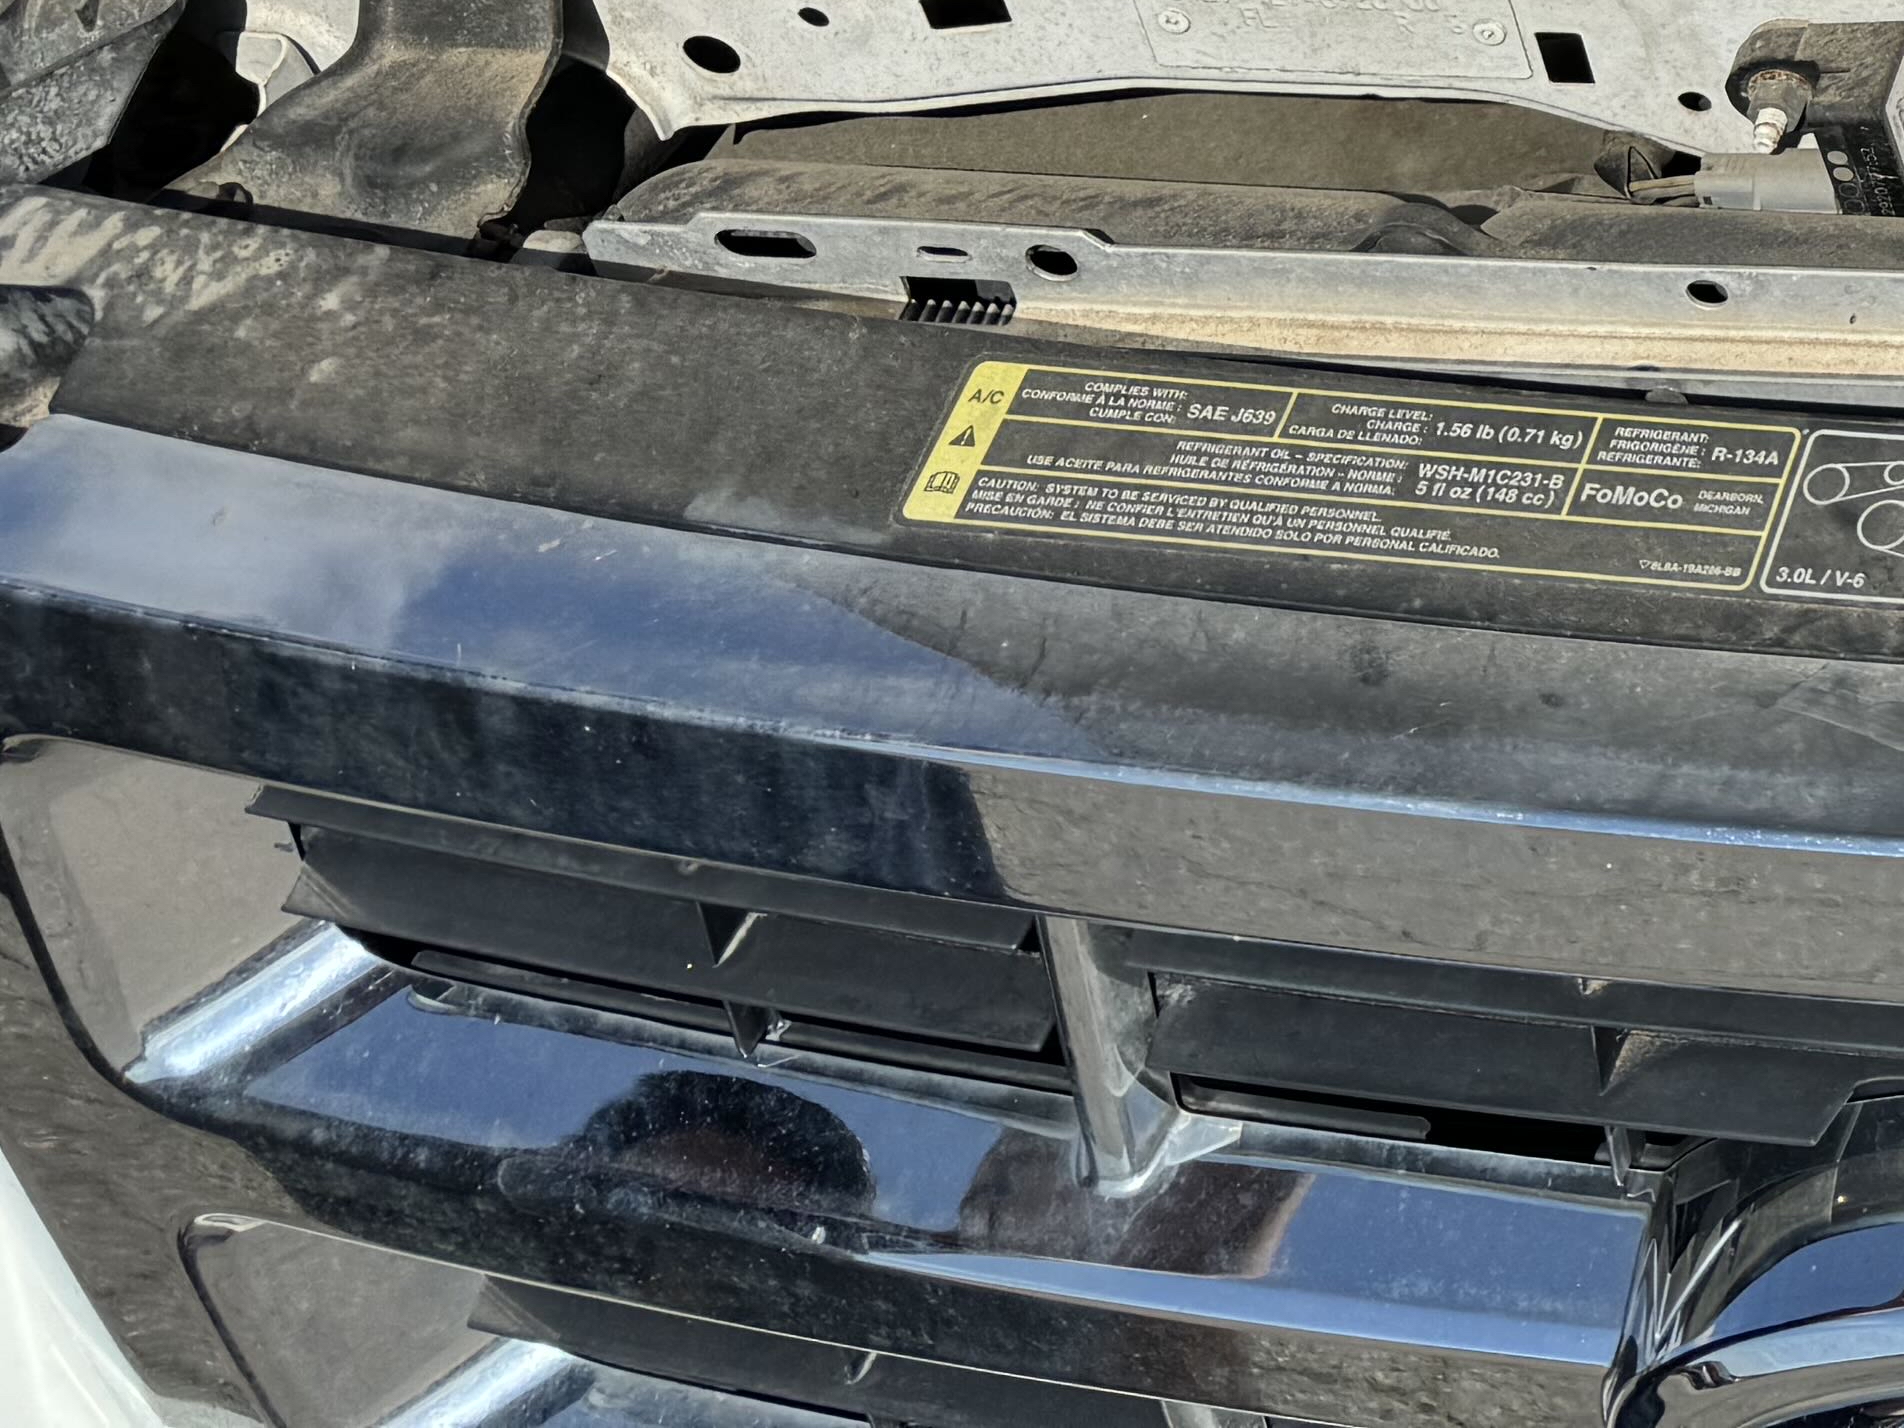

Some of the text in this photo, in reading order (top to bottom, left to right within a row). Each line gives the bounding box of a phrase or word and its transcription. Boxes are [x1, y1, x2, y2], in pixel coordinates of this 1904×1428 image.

[968, 388, 1005, 404] A/C
[1085, 382, 1149, 396] COMPLIES
[1022, 389, 1094, 404] CONFORME
[1108, 395, 1125, 406] LA
[1128, 398, 1175, 411] NORME
[1089, 407, 1143, 421] CUMPLE
[1187, 403, 1276, 425] SAE J639
[1331, 404, 1433, 421] CHARGE LEVEL:
[1288, 424, 1423, 445] CARGA DE LLENADO:
[1366, 419, 1421, 433] CHARGE
[1435, 421, 1583, 450] 1.56 lb (0.71 kg)
[1615, 426, 1710, 443] REFRIGERANT:
[1170, 453, 1209, 467] HUILE
[1176, 440, 1269, 458] REFRIGERANT
[1270, 448, 1291, 459] OIL
[1597, 451, 1702, 469] REFRIGERANTE:
[1711, 446, 1779, 465] R-134A
[1026, 454, 1054, 466] USE
[1055, 456, 1103, 470] ACEITE
[1105, 461, 1140, 474] PARA
[1143, 463, 1252, 484] REFRIGERANTES
[1255, 474, 1329, 490] CONFORME
[1418, 463, 1565, 489] WSH-M1C231-B
[978, 476, 1039, 492] CAUTION:
[1045, 482, 1099, 496] SYSTEM
[1101, 488, 1119, 499] TO
[1121, 489, 1140, 501] BE
[1141, 491, 1208, 506] SERVICED
[1208, 497, 1229, 508] BY
[1229, 499, 1299, 514] QUALIFIED
[1415, 480, 1555, 508] 5 fl oz (148 cc)
[1580, 482, 1684, 510] FoMoCo
[971, 489, 1005, 502] MISE
[1005, 492, 1026, 503] EN
[1027, 494, 1074, 508] GARDE
[1085, 500, 1104, 511] NE
[1107, 502, 1164, 516] CONFIER
[1286, 518, 1306, 529] UN
[1307, 519, 1387, 536] PERSONNEL
[1693, 502, 1751, 516] MICHIGAN
[1060, 511, 1078, 521] EL
[1079, 512, 1135, 527] SISTEMA
[1138, 517, 1175, 530] DEBE
[1177, 520, 1204, 533] SER
[1205, 524, 1273, 539] ATENDIDO
[1274, 530, 1311, 542] SOLO
[1313, 533, 1343, 545] POR
[1345, 536, 1416, 552] PERSONAL
[1418, 541, 1500, 559] CALIFICADO.
[1776, 567, 1817, 586] 3.0L
[1834, 570, 1866, 589] V-6
